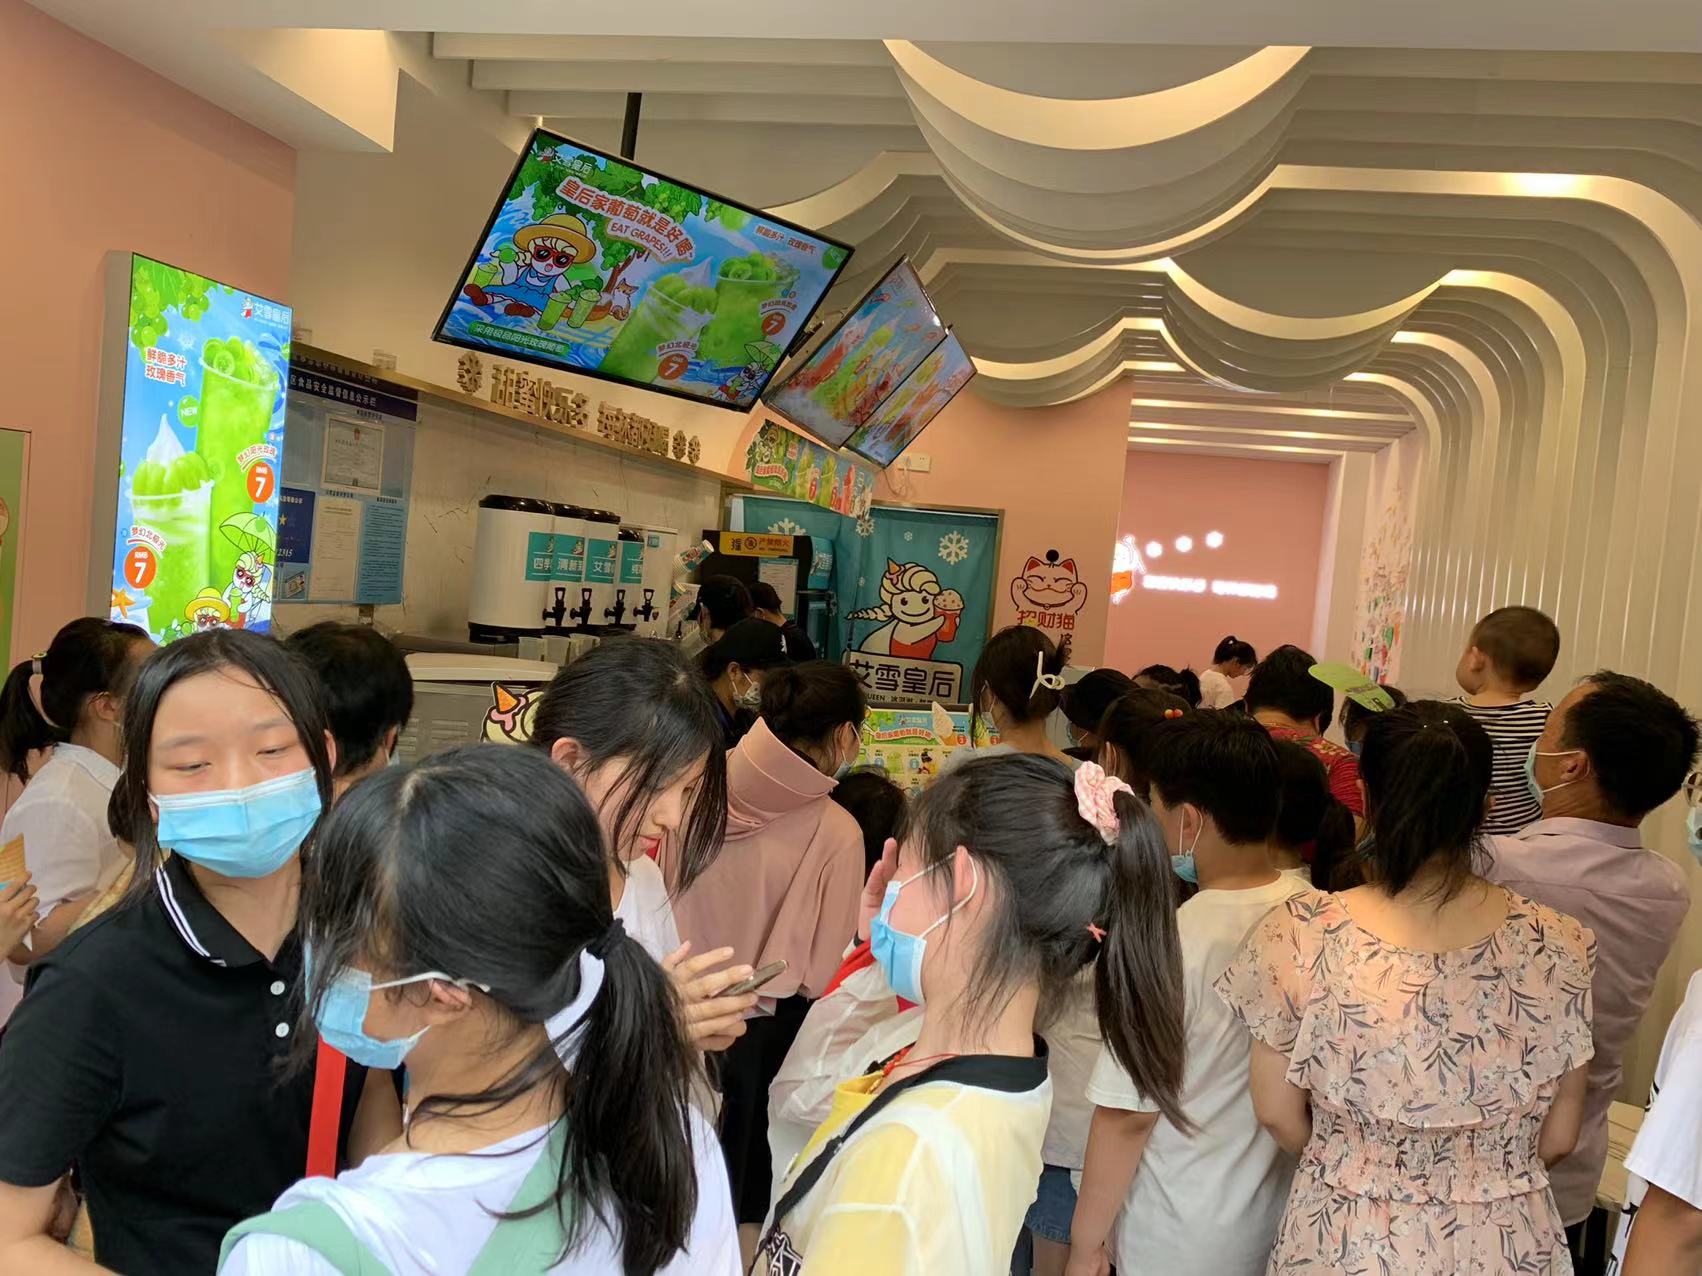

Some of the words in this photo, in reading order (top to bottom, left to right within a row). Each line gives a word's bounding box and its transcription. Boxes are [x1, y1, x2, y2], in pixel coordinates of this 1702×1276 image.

[611, 222, 630, 234] EAT
[631, 228, 673, 258] GRAPES!!!
[766, 319, 779, 332] 7
[146, 347, 186, 369] 鲜脆多汁
[664, 361, 680, 376] 7
[180, 407, 198, 416] NEW
[255, 477, 266, 498] 7
[134, 562, 147, 584] 7
[1016, 609, 1076, 631] 招财猫
[850, 659, 956, 698] 艾雪皇后
[866, 693, 886, 701] UEEN
